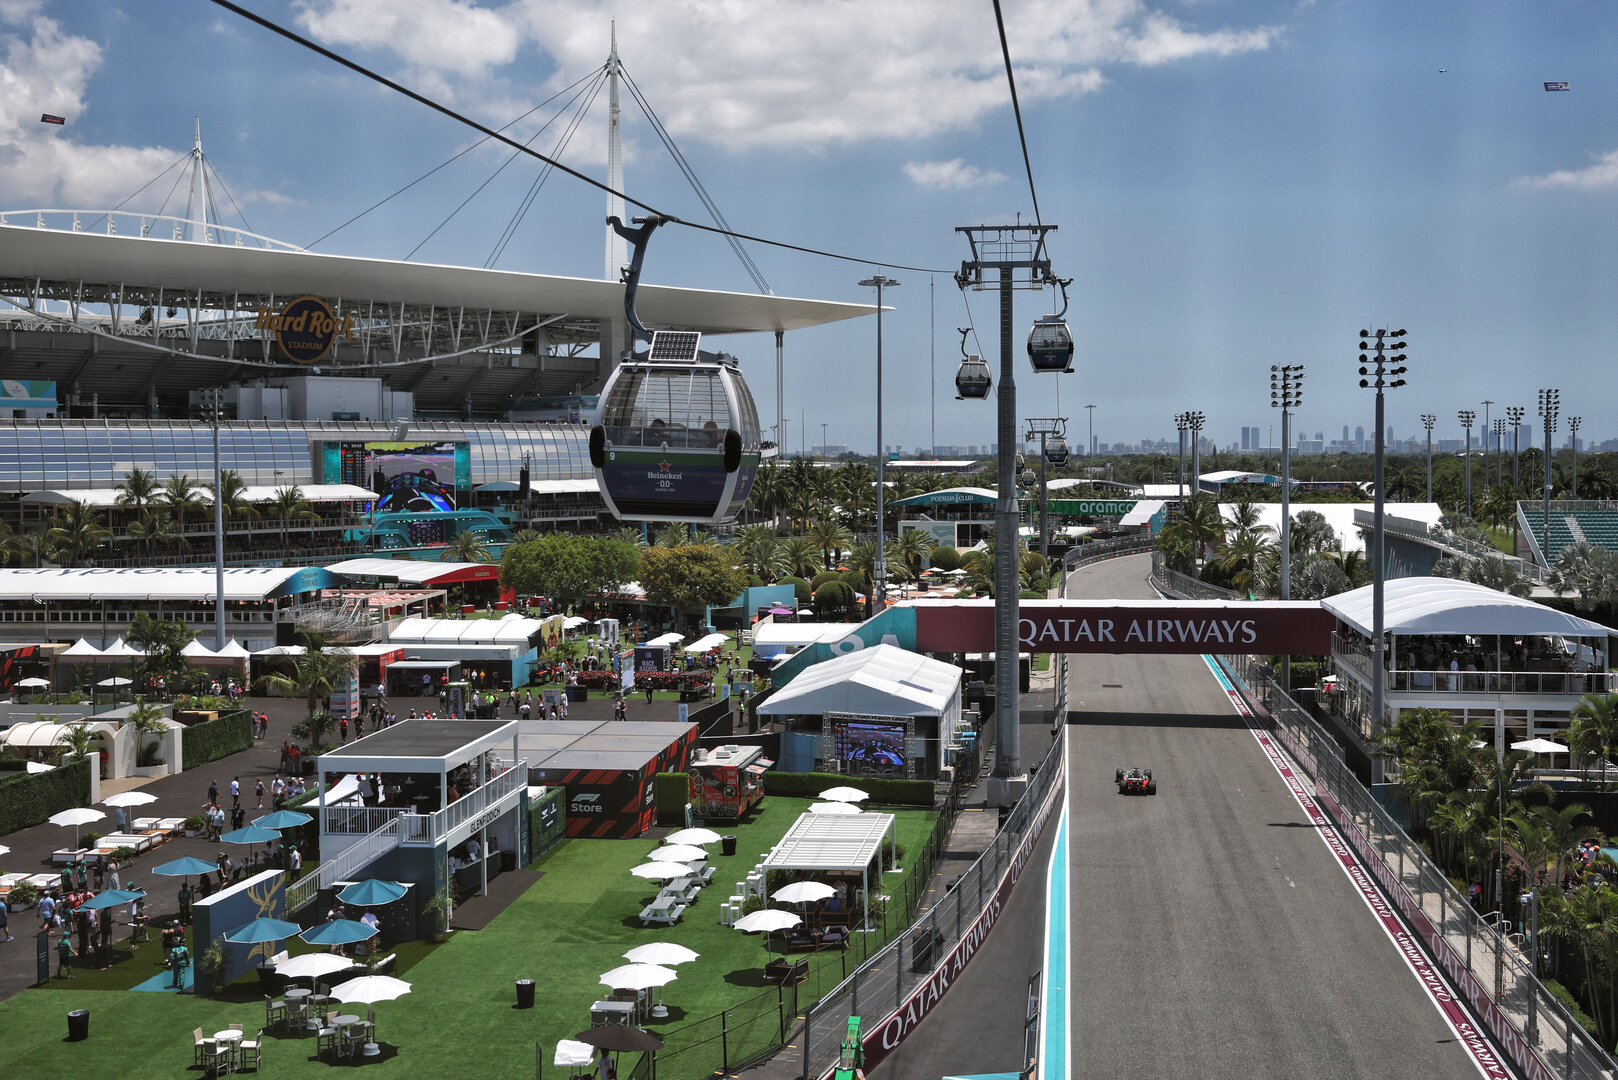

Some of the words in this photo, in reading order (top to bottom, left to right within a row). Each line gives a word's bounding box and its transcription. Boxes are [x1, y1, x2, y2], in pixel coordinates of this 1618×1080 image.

[255, 307, 309, 332] Hard
[308, 310, 355, 339] Rock
[287, 341, 323, 351] STADIUM
[609, 452, 616, 460] 9
[647, 472, 682, 480] Heineken
[1080, 502, 1134, 514] aramco
[11, 568, 273, 577] crypto.com
[1018, 616, 1116, 650] QATAR
[1124, 619, 1257, 643] AIRWAYS
[571, 793, 602, 802] F1
[571, 803, 602, 813] Store
[470, 805, 501, 833] GLENFIDDICH
[1368, 855, 1411, 919] AIRWAYS
[1366, 892, 1392, 918] QATAR
[1396, 931, 1428, 967] AIRWAYS
[882, 962, 949, 1051] QATAR
[951, 892, 1001, 980] AIRWAYS
[1419, 969, 1451, 1002] QATAR
[1431, 932, 1480, 1013] QATAR
[1483, 1001, 1549, 1080] AIRWA
[1458, 1022, 1505, 1075] AIRWAYS
